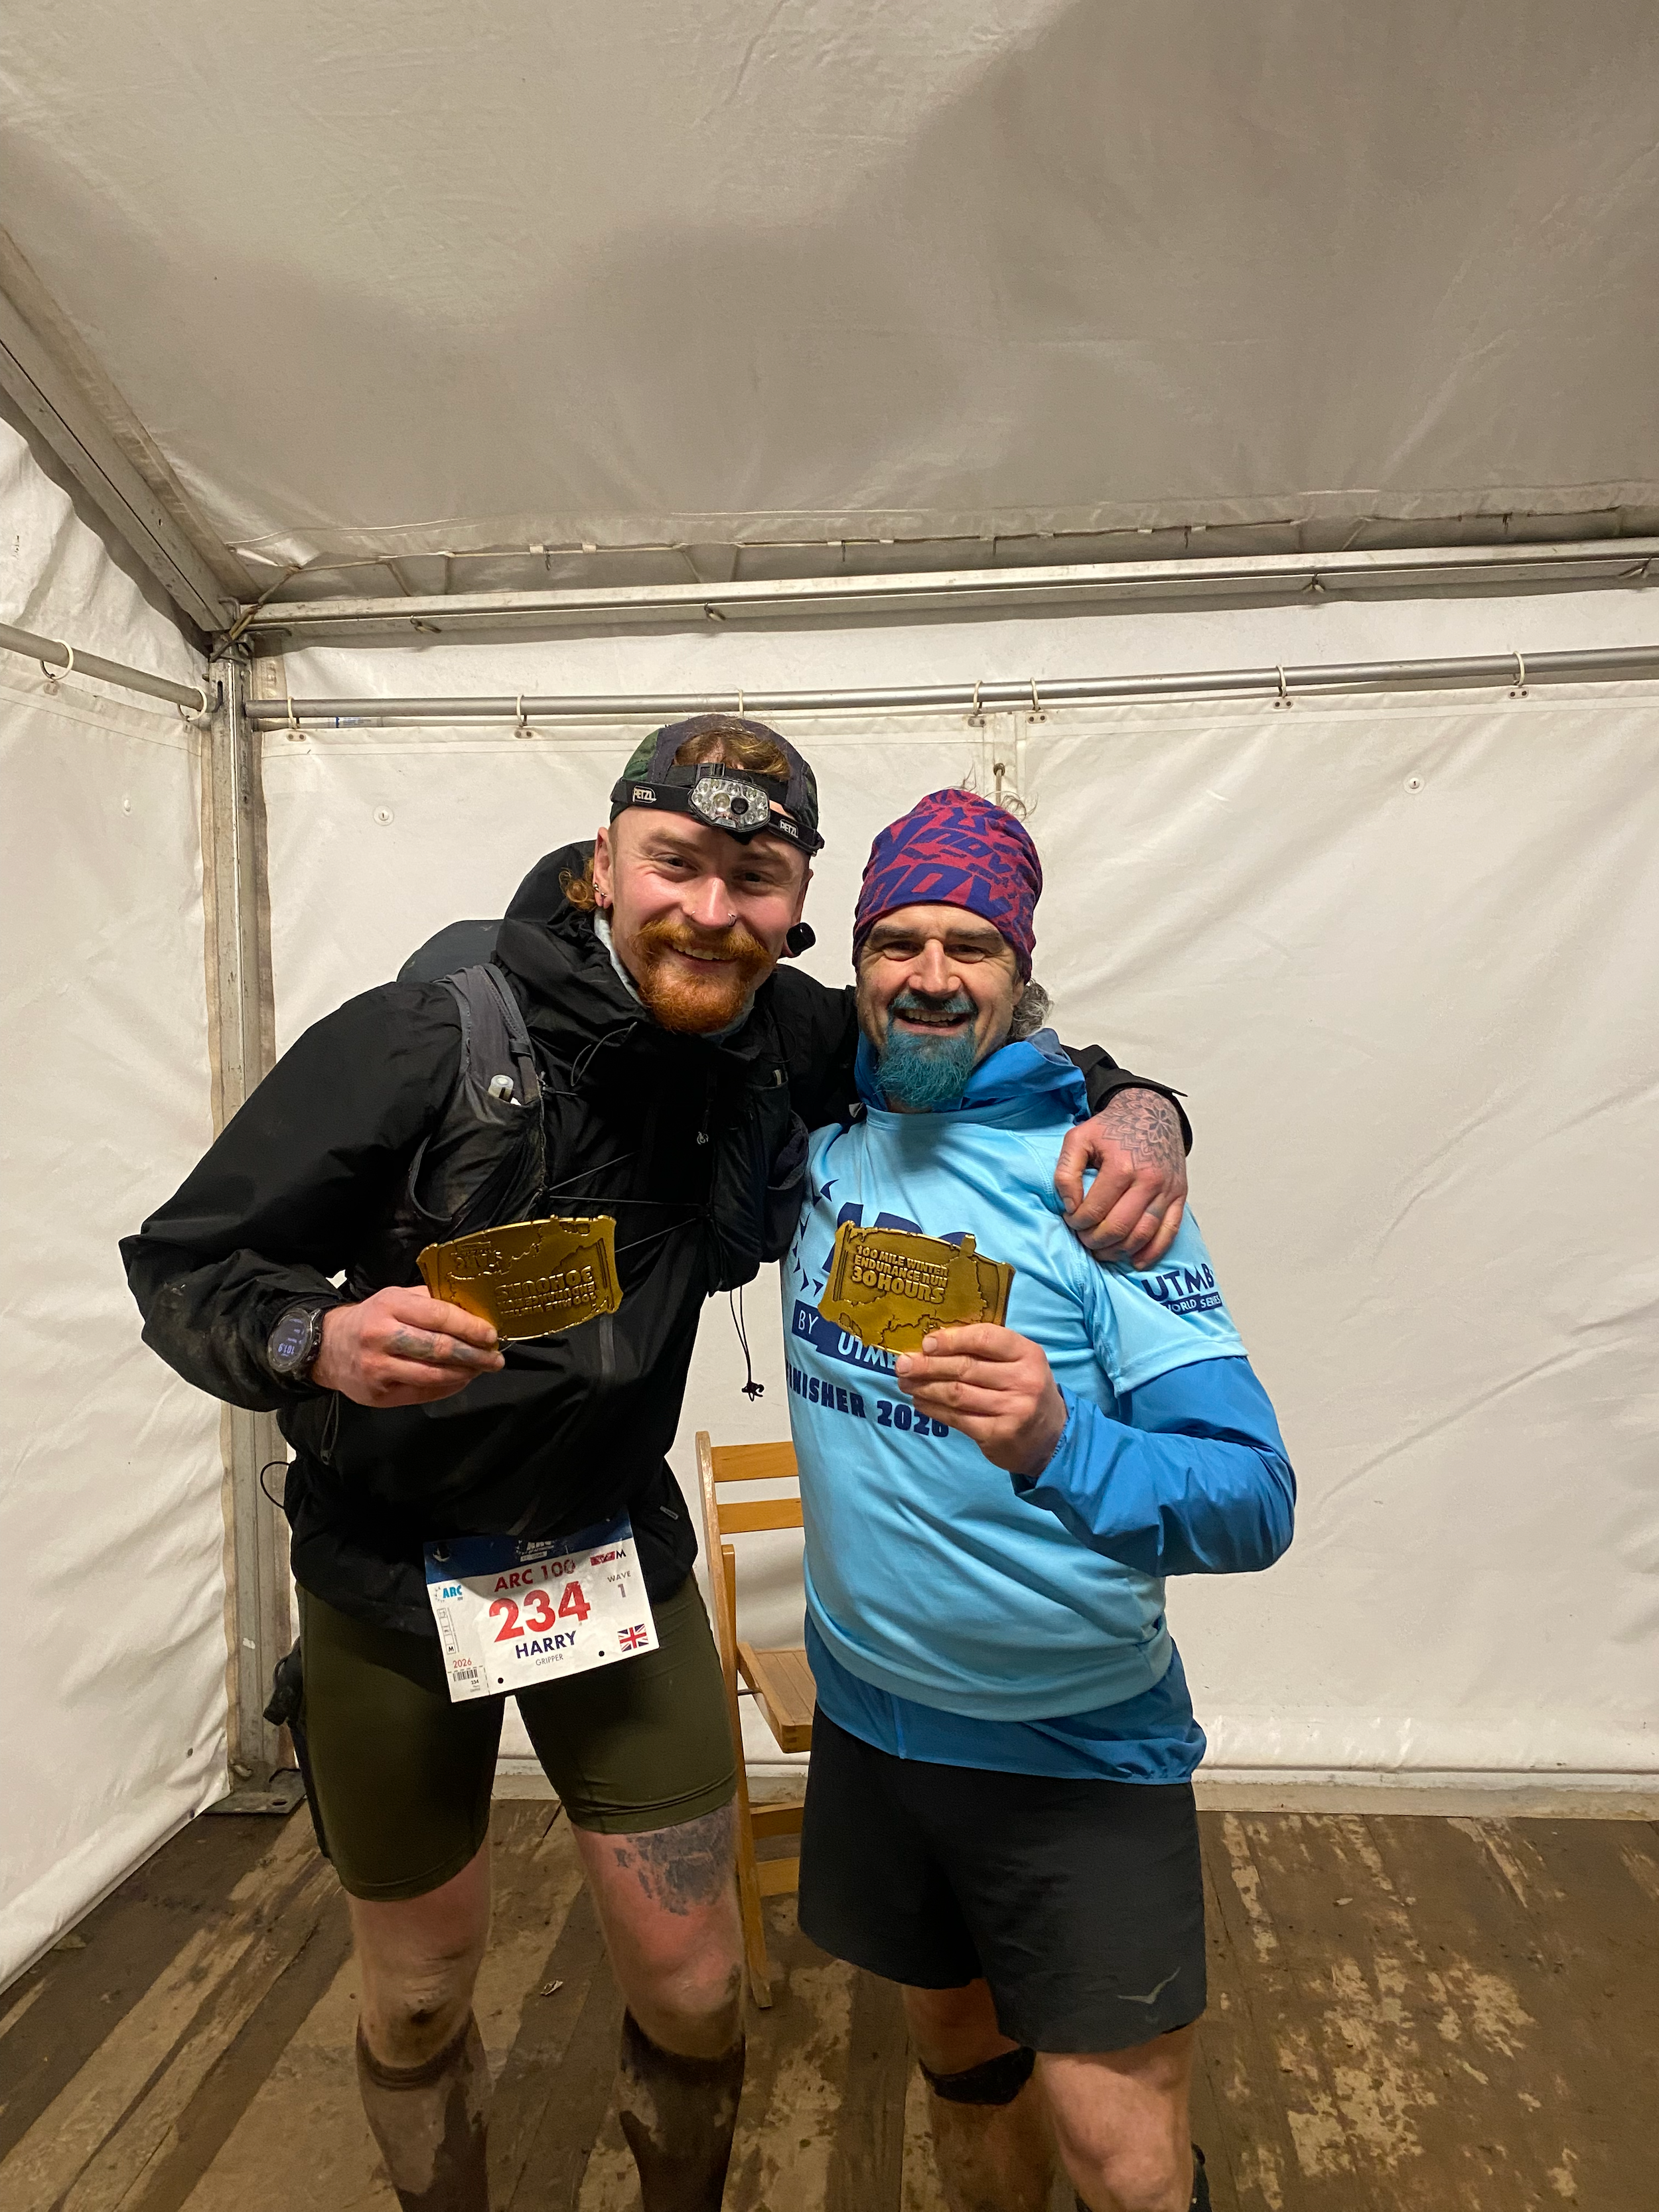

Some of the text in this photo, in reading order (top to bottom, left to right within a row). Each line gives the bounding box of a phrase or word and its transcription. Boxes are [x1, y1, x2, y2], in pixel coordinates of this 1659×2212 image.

[632, 787, 656, 802] PETZL
[854, 1254, 948, 1288] ENDURANCE RUN
[857, 1245, 949, 1277] 100 MILE WINTER
[851, 1265, 945, 1304] 30 HOURS
[1141, 1263, 1214, 1301] UTMB
[1200, 1294, 1221, 1308] SERIES
[798, 1310, 819, 1334] BY
[494, 1568, 534, 1592] ARC
[541, 1558, 576, 1580] 100
[607, 1570, 631, 1582] WAVE
[443, 1584, 463, 1598] ARC
[617, 1583, 626, 1598] 1
[488, 1580, 591, 1643] 234
[515, 1630, 577, 1659] HARRY
[453, 1658, 472, 1669] 2026
[536, 1653, 564, 1666] GRIPPER
